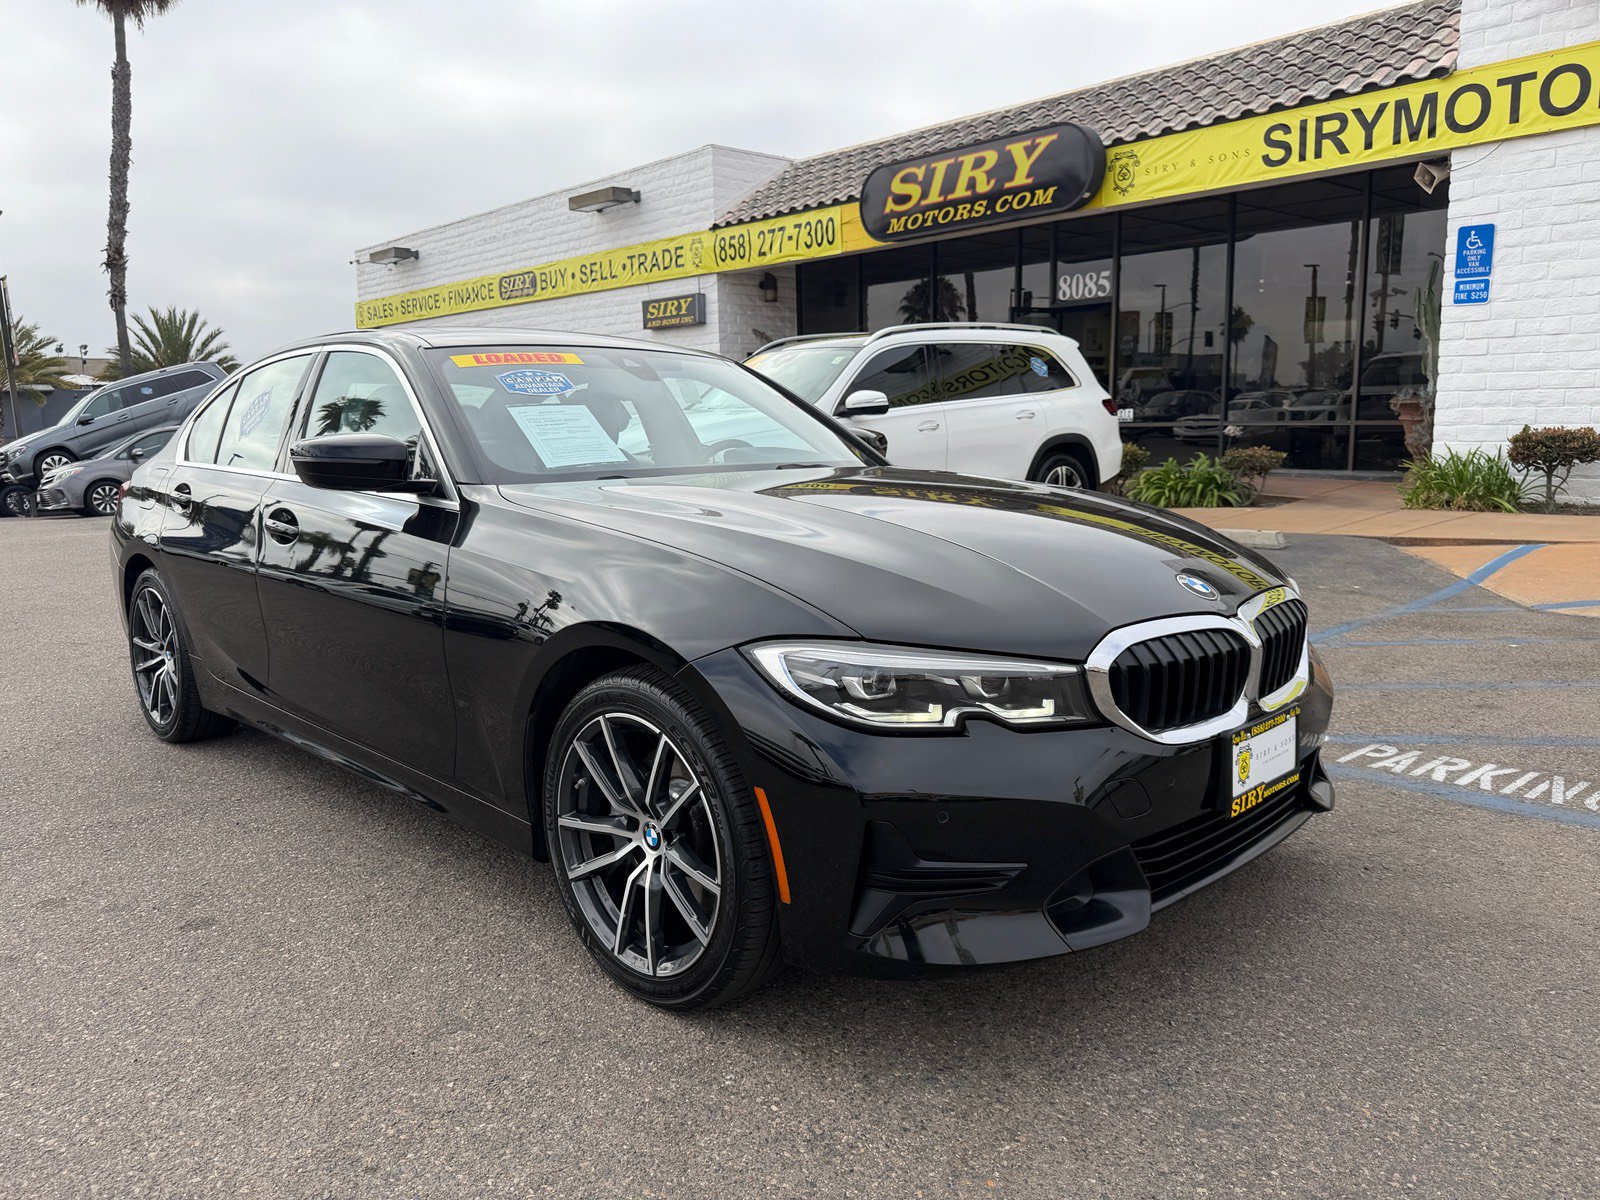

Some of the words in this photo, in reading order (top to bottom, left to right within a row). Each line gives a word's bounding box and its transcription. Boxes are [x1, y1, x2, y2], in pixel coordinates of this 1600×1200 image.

[1261, 62, 1600, 168] SIRYMOTO
[883, 132, 1058, 214] SIRY
[1144, 162, 1178, 176] SIRY
[1208, 148, 1250, 164] SONS
[886, 186, 1058, 234] MOTORS.COM
[713, 229, 752, 267] (858)
[757, 217, 836, 258] 277-7300
[1463, 248, 1487, 256] PARKING
[502, 273, 535, 291] SIRY
[539, 268, 568, 291] BUY
[580, 259, 618, 284] SELL
[627, 246, 684, 276] TRADE
[1456, 266, 1490, 275] ACCESSIBLE
[1058, 271, 1112, 301] 8085
[1454, 292, 1468, 301] FINE
[1459, 283, 1486, 291] MINIMUM
[367, 303, 394, 321] SALES
[400, 293, 441, 315] SERVICE
[448, 282, 495, 306] FINANCE
[646, 297, 693, 319] SIRY
[472, 353, 565, 365] LOADED
